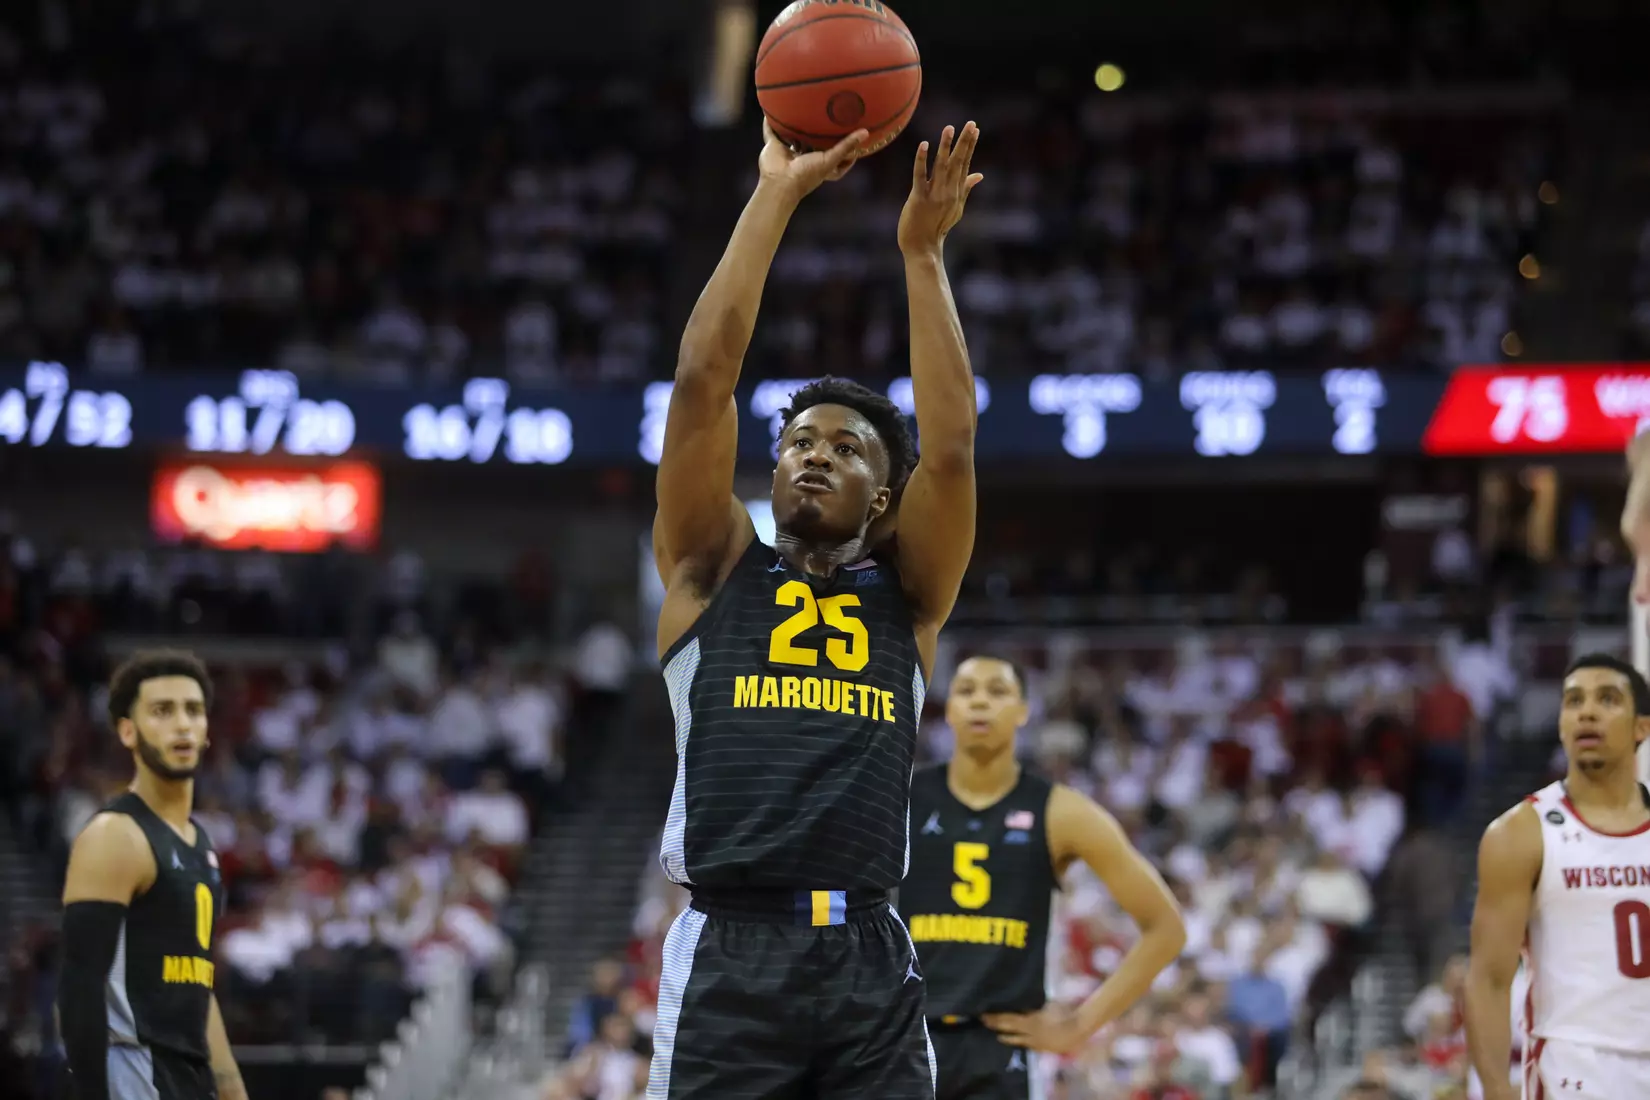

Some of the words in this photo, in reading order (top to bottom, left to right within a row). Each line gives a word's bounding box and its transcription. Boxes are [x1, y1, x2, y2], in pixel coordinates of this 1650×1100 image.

[769, 580, 869, 672] 25
[733, 674, 896, 723] MARQUETTE
[951, 841, 991, 910] 5
[1562, 865, 1650, 890] WISCON
[195, 881, 214, 951] 0
[1614, 899, 1650, 979] 0
